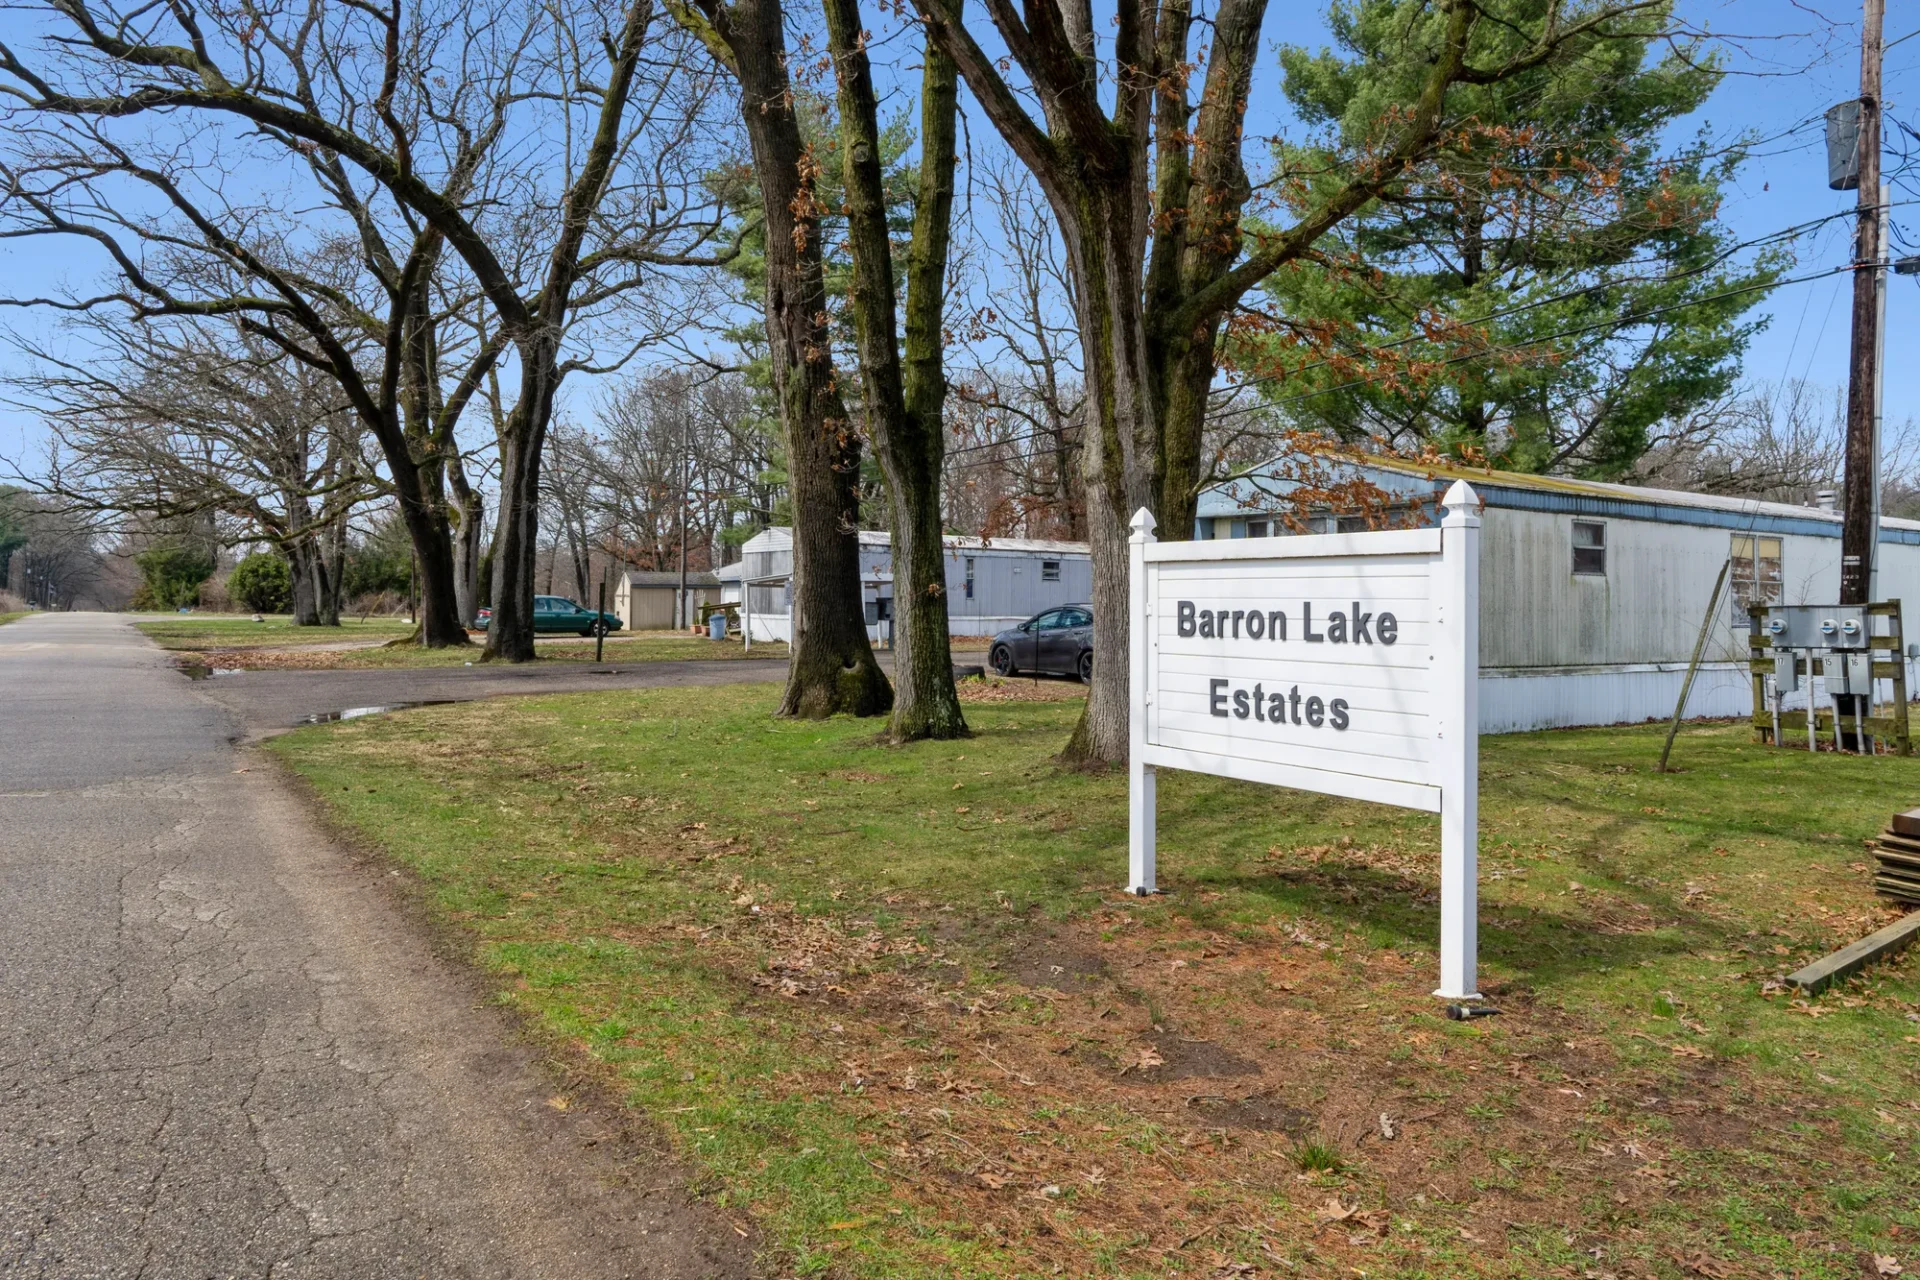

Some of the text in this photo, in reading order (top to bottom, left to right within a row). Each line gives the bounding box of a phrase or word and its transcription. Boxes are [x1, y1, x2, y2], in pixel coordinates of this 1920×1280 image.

[1178, 601, 1398, 646] Barron Lake
[1825, 658, 1833, 666] 15
[1210, 679, 1350, 731] Estates
